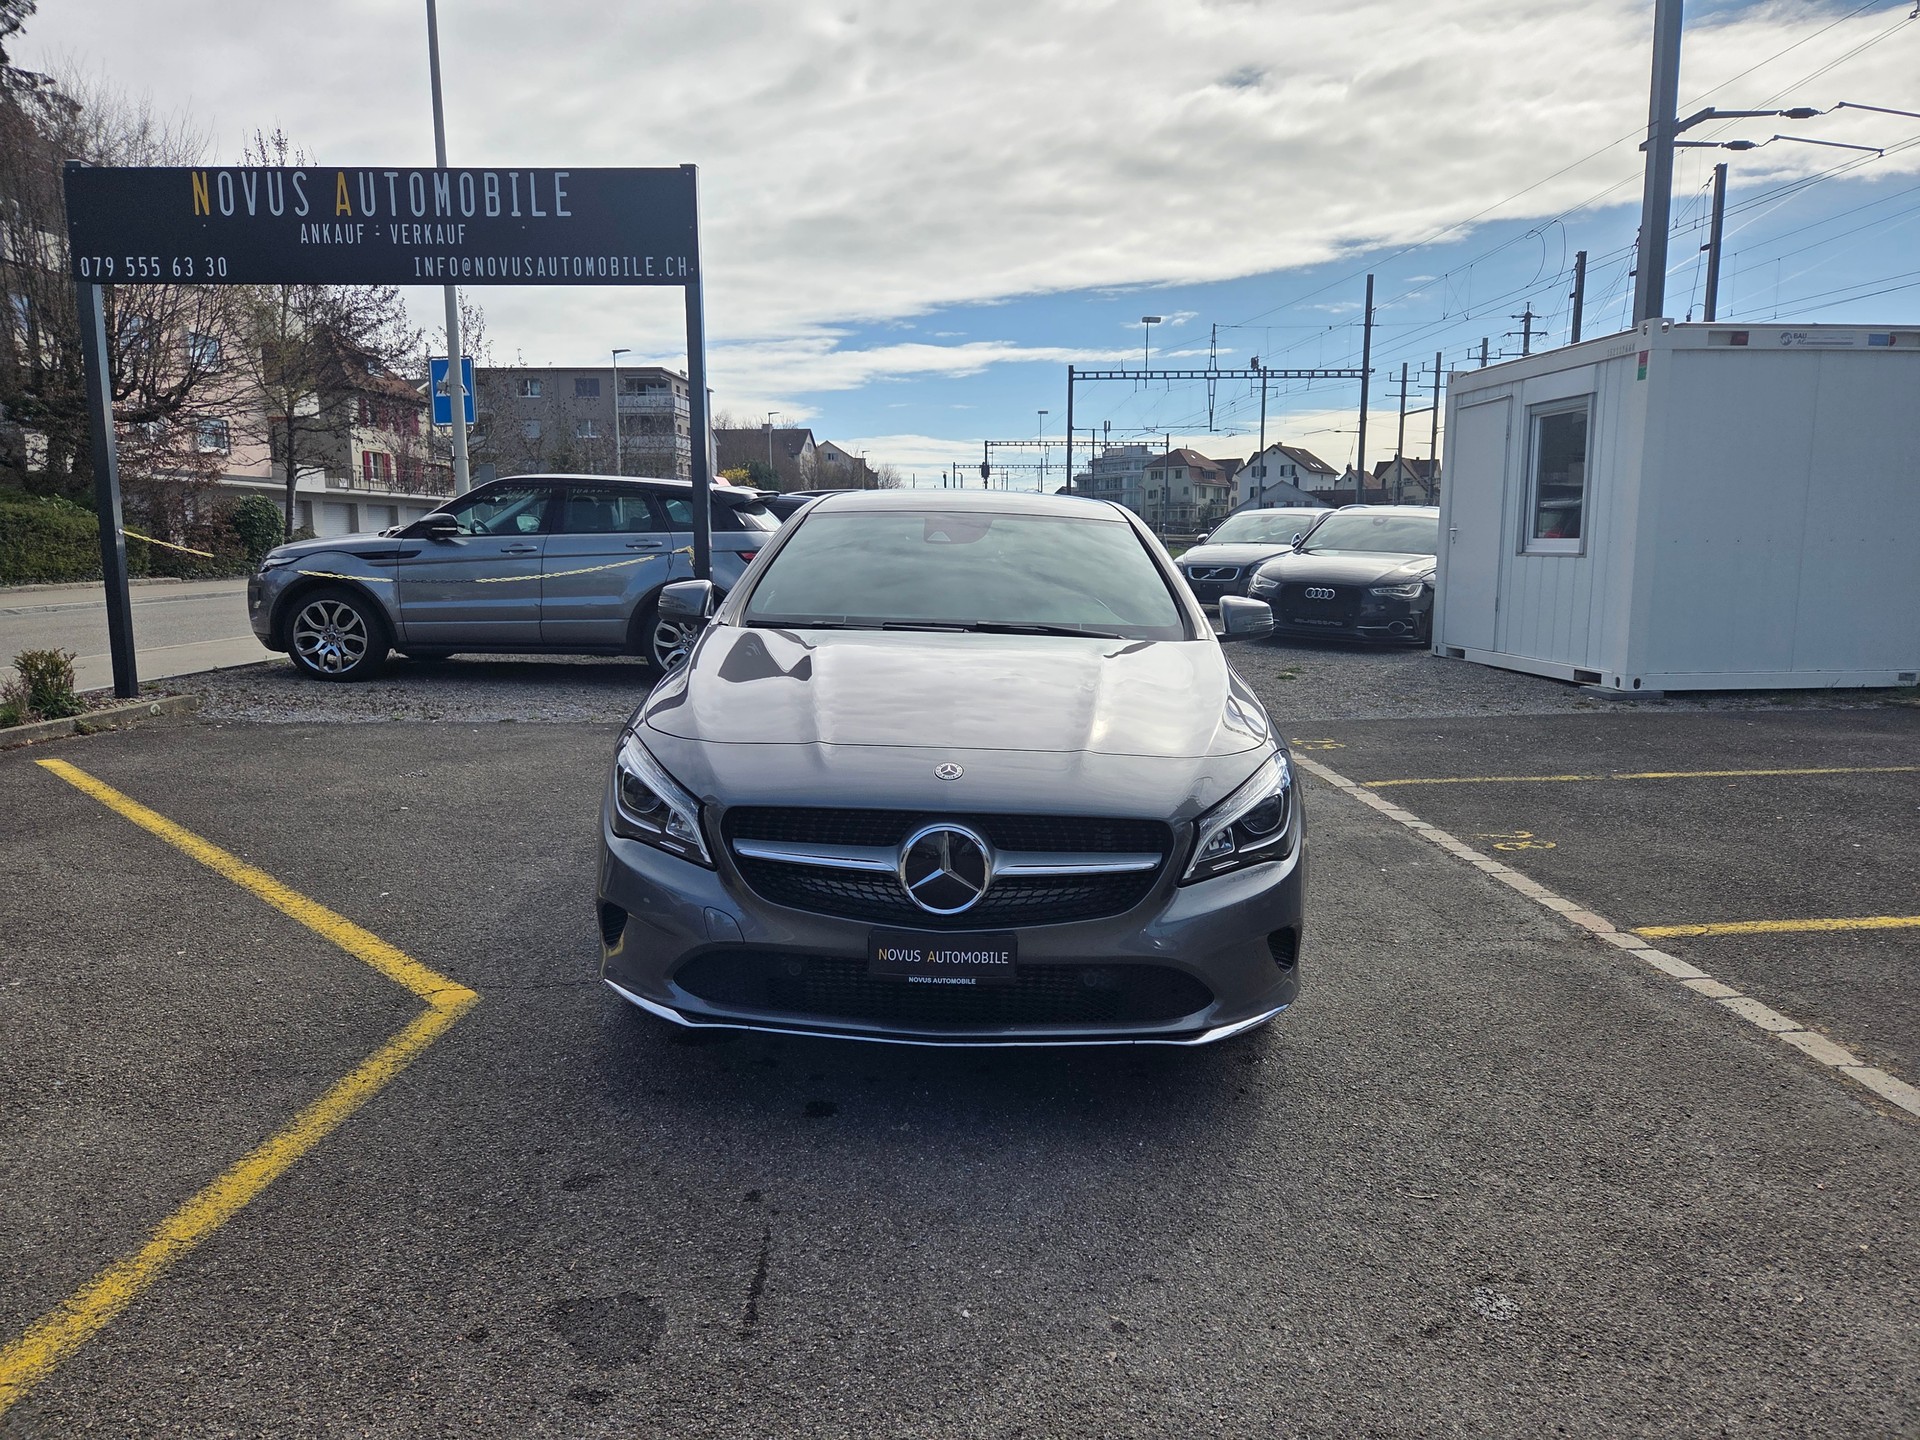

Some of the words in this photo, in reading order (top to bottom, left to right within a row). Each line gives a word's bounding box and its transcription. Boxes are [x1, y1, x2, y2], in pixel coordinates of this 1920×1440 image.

[192, 171, 310, 216] NOVUS
[335, 171, 572, 217] AUTOMOBILE
[300, 223, 364, 244] ANKAUF
[390, 223, 466, 245] VERKAUF
[80, 256, 114, 277] 079
[125, 256, 161, 277] 555
[172, 256, 194, 277] 63
[205, 256, 228, 277] 30
[414, 256, 688, 277] INFO@NOVUSAUTOMOBILE.CH
[878, 948, 921, 963] NOVUS
[927, 950, 1009, 964] AUTOMOBILE
[908, 976, 932, 984] NOVUS
[932, 977, 977, 985] AUTOMOBILE
